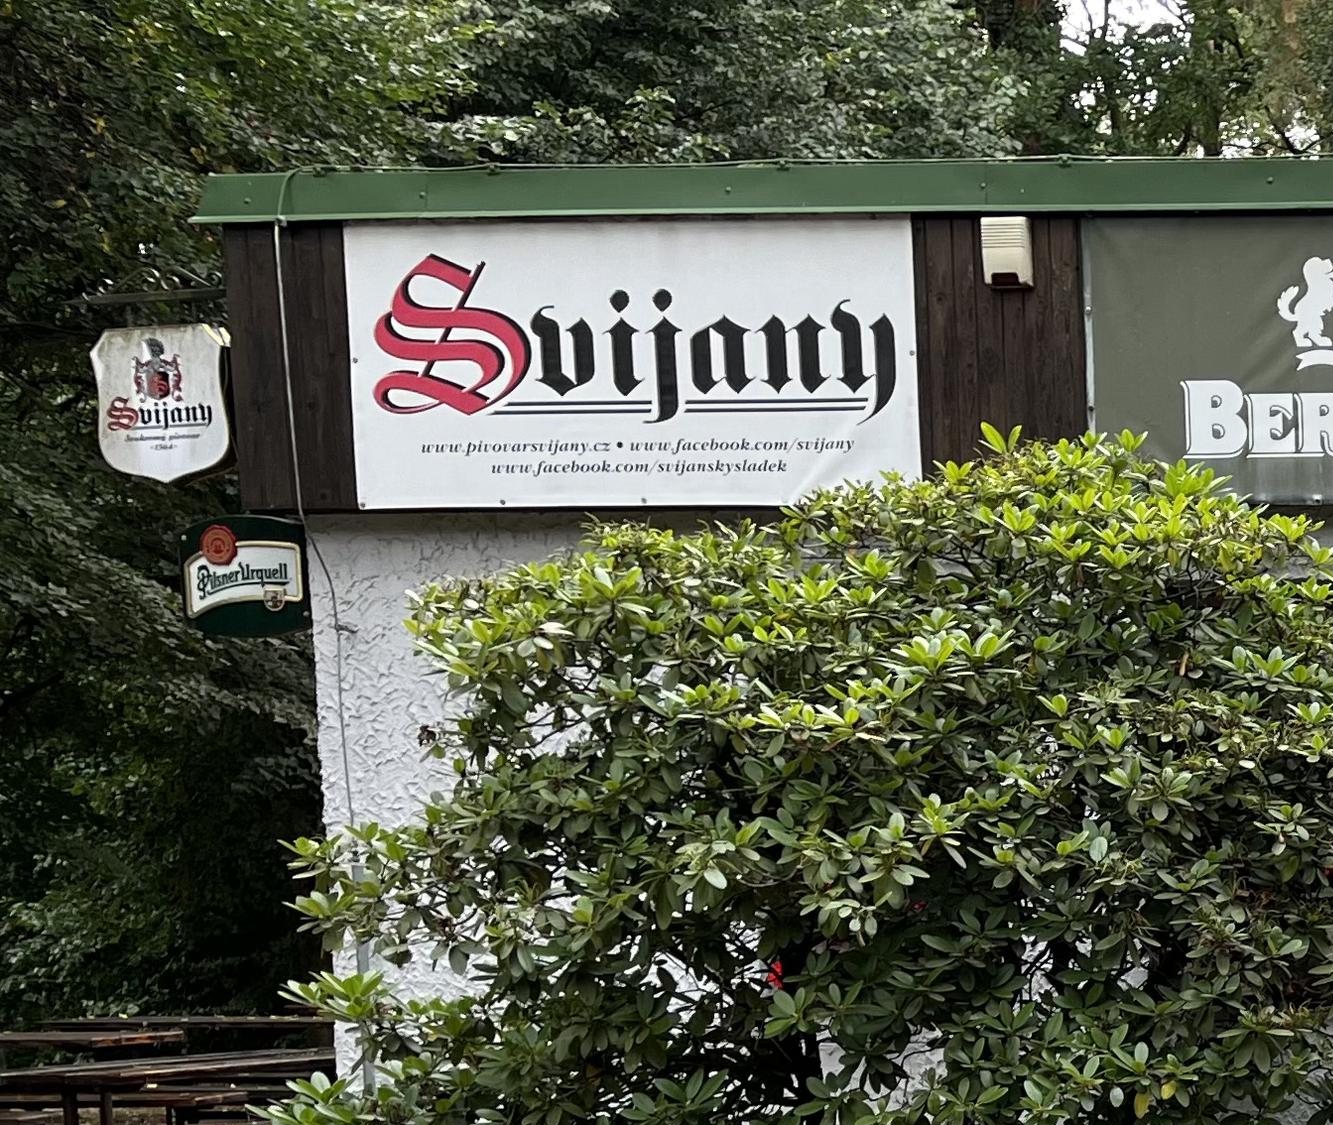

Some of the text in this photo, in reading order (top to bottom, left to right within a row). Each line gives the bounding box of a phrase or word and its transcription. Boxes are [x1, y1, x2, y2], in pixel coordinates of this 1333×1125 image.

[372, 253, 897, 426] Svijany
[107, 396, 213, 432] Svijany
[421, 435, 855, 457] www.pivovarsvijany.cz www.facebook.com/svijany
[491, 457, 788, 477] www.facebook.com/svijanskysladek
[197, 561, 288, 600] Pilsner Urquell
